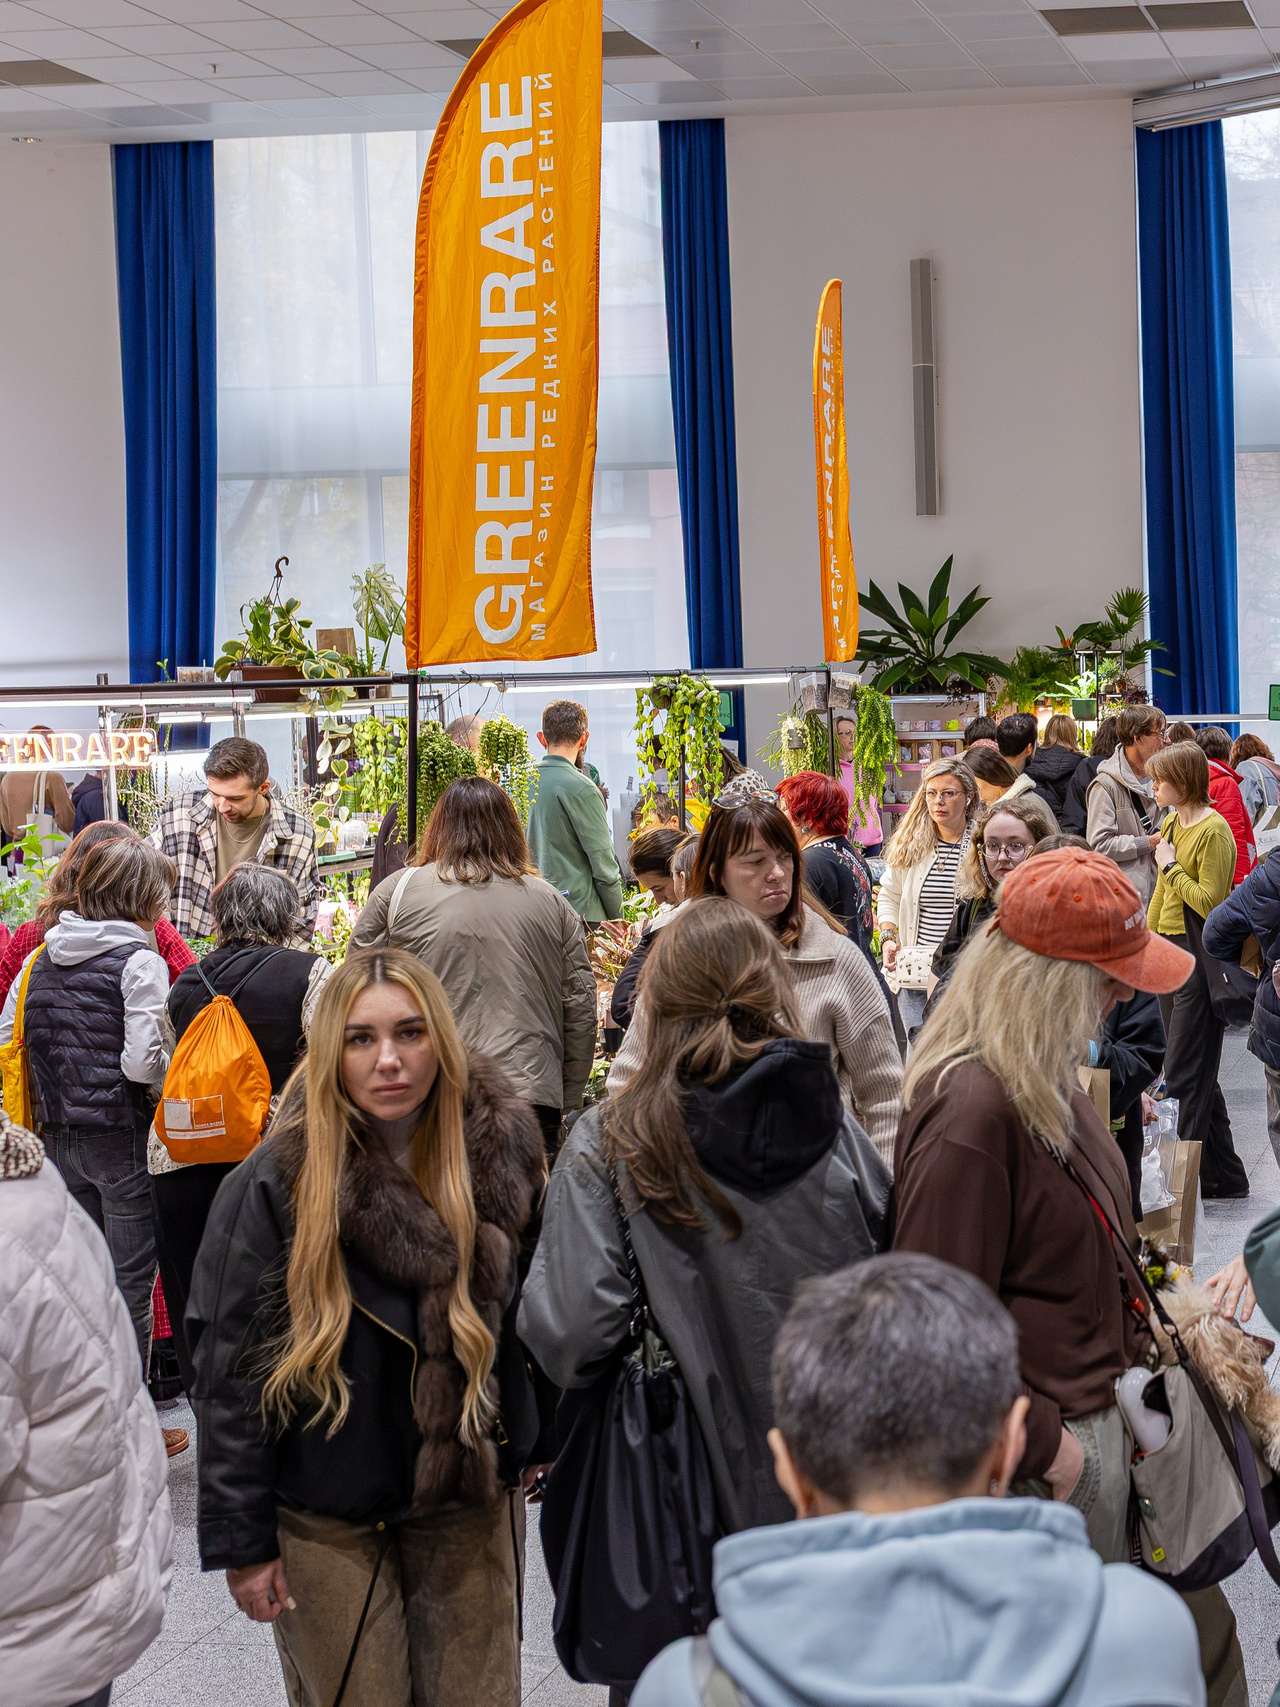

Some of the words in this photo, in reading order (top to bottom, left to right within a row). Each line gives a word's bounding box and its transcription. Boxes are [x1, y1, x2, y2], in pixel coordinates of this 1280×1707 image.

[533, 72, 555, 274] РАСТЕНИЙ
[474, 75, 537, 644] GREENRARE
[541, 300, 560, 448] РЕДКИХ
[529, 475, 554, 641] МАГАЗИН
